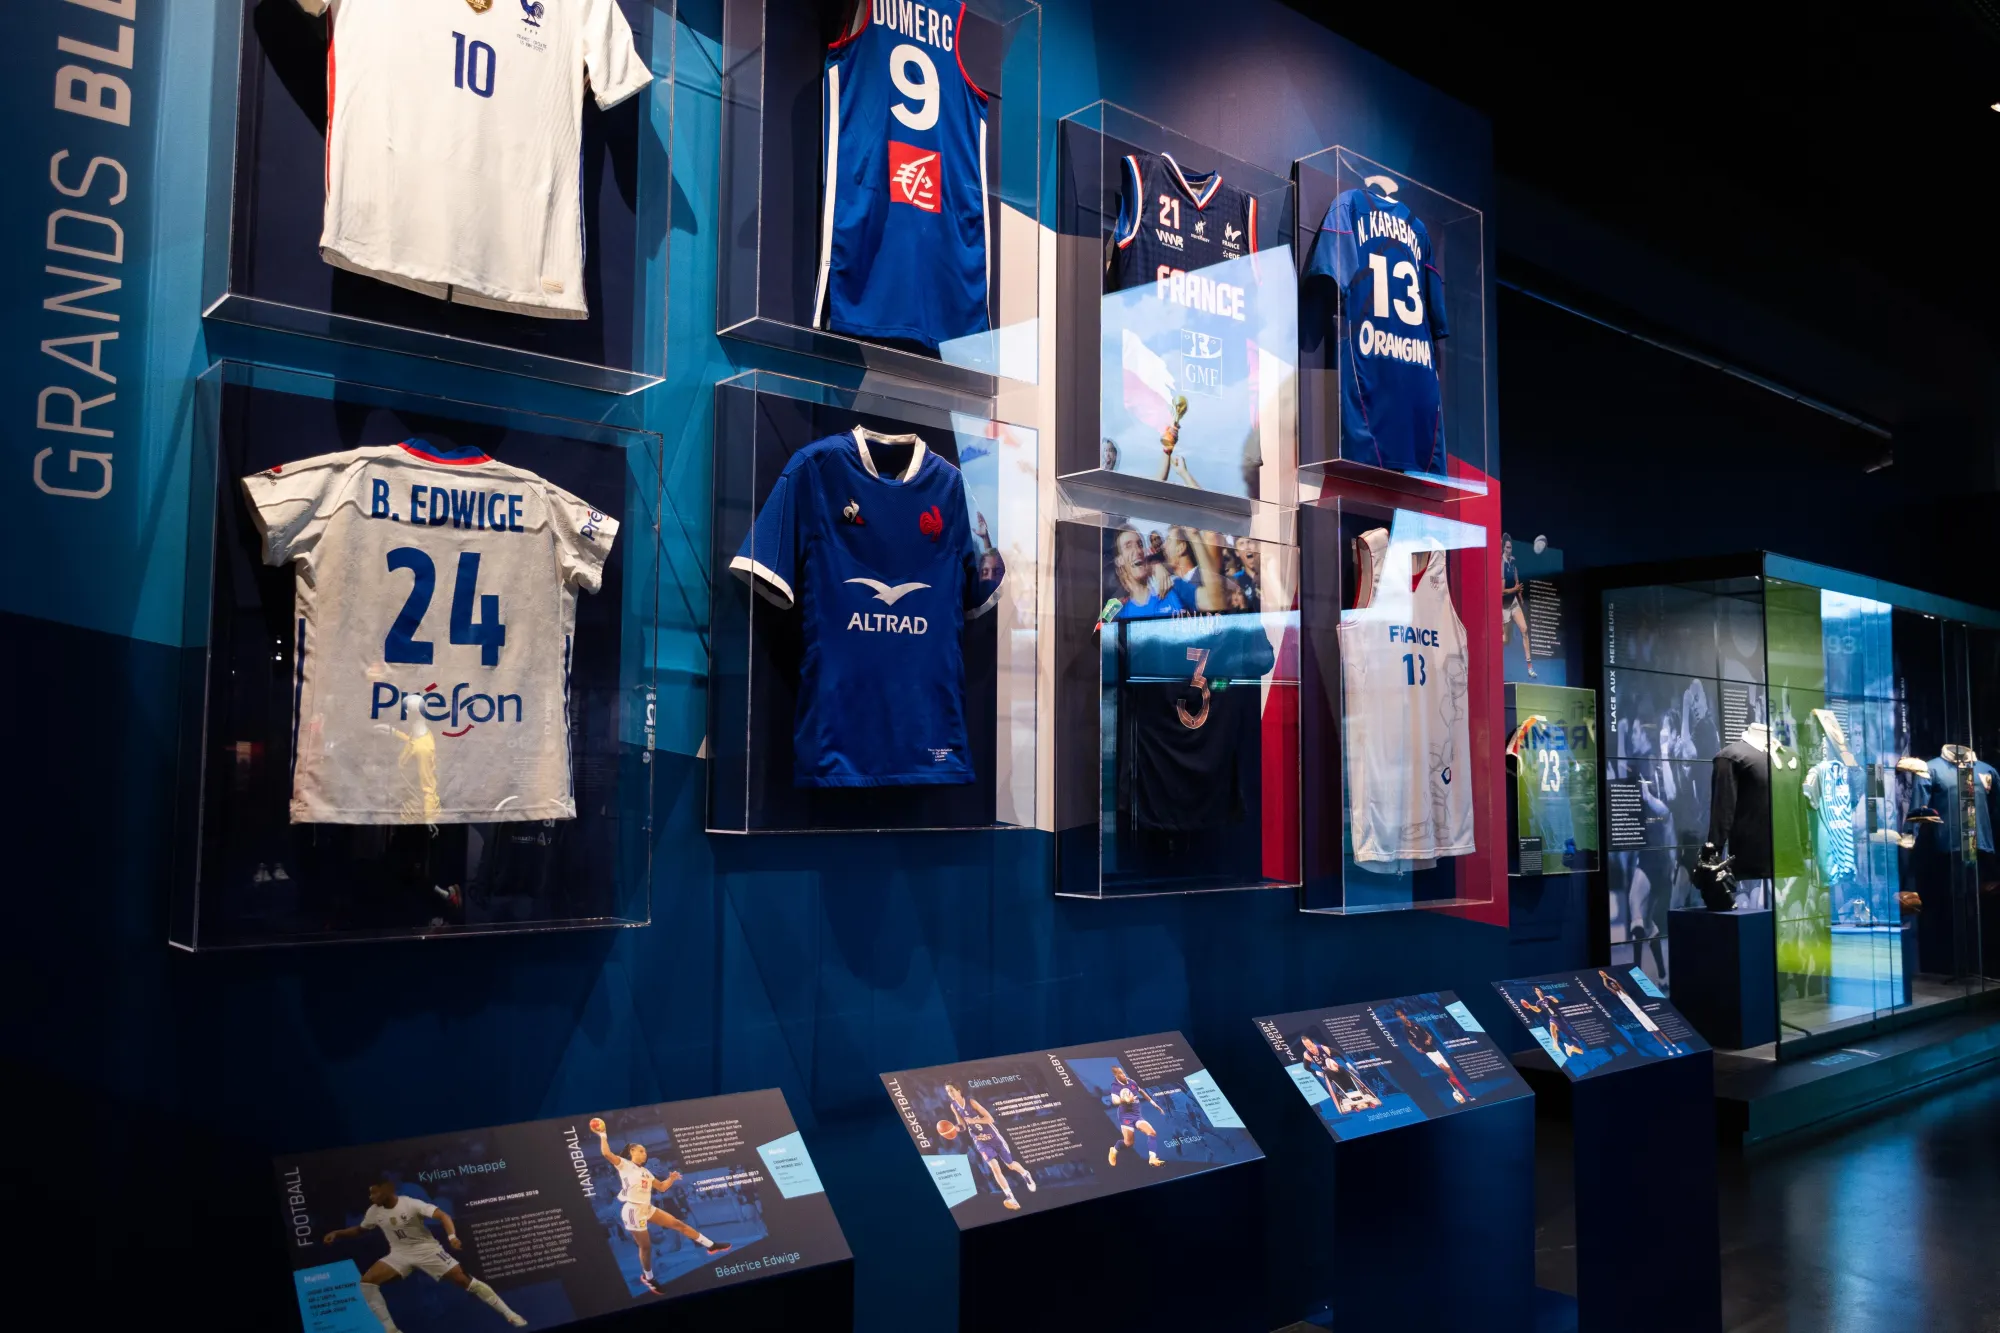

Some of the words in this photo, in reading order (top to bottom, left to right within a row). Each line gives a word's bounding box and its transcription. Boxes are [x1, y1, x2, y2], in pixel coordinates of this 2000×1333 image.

[452, 30, 496, 98] 10
[889, 43, 940, 131] 9
[1159, 194, 1180, 230] 21
[1357, 216, 1369, 247] N.
[1157, 264, 1246, 322] FRANCE
[1369, 252, 1424, 326] 13
[33, 148, 129, 500] GRANDS
[1185, 363, 1219, 387] GMF
[371, 478, 400, 522] B.
[410, 484, 525, 533] EDWIGE
[383, 547, 506, 666] 24
[847, 612, 928, 635] ALTRAD
[1388, 625, 1440, 648] FRANCE
[1176, 646, 1211, 730] 3
[1402, 653, 1427, 687] 13
[1538, 748, 1561, 792] 23
[1499, 986, 1531, 1024] HANDBALL
[1574, 975, 1612, 1018] BASKETBALL
[1259, 1021, 1283, 1051] RUGBY
[1268, 1019, 1297, 1061] FAUTEUIL
[1366, 1006, 1399, 1048] FOOTBALL
[968, 1079, 992, 1088] Céline
[993, 1074, 1022, 1084] Dumerc
[1047, 1053, 1073, 1087] RUGBY
[889, 1078, 931, 1148] BASKETBALL
[418, 1167, 456, 1183] Kylian
[458, 1159, 507, 1175] Mbappé
[563, 1125, 596, 1197] HANDBALL
[284, 1166, 314, 1247] FOOTBALL
[715, 1260, 761, 1278] Béatrice
[762, 1251, 801, 1267] Edwige
